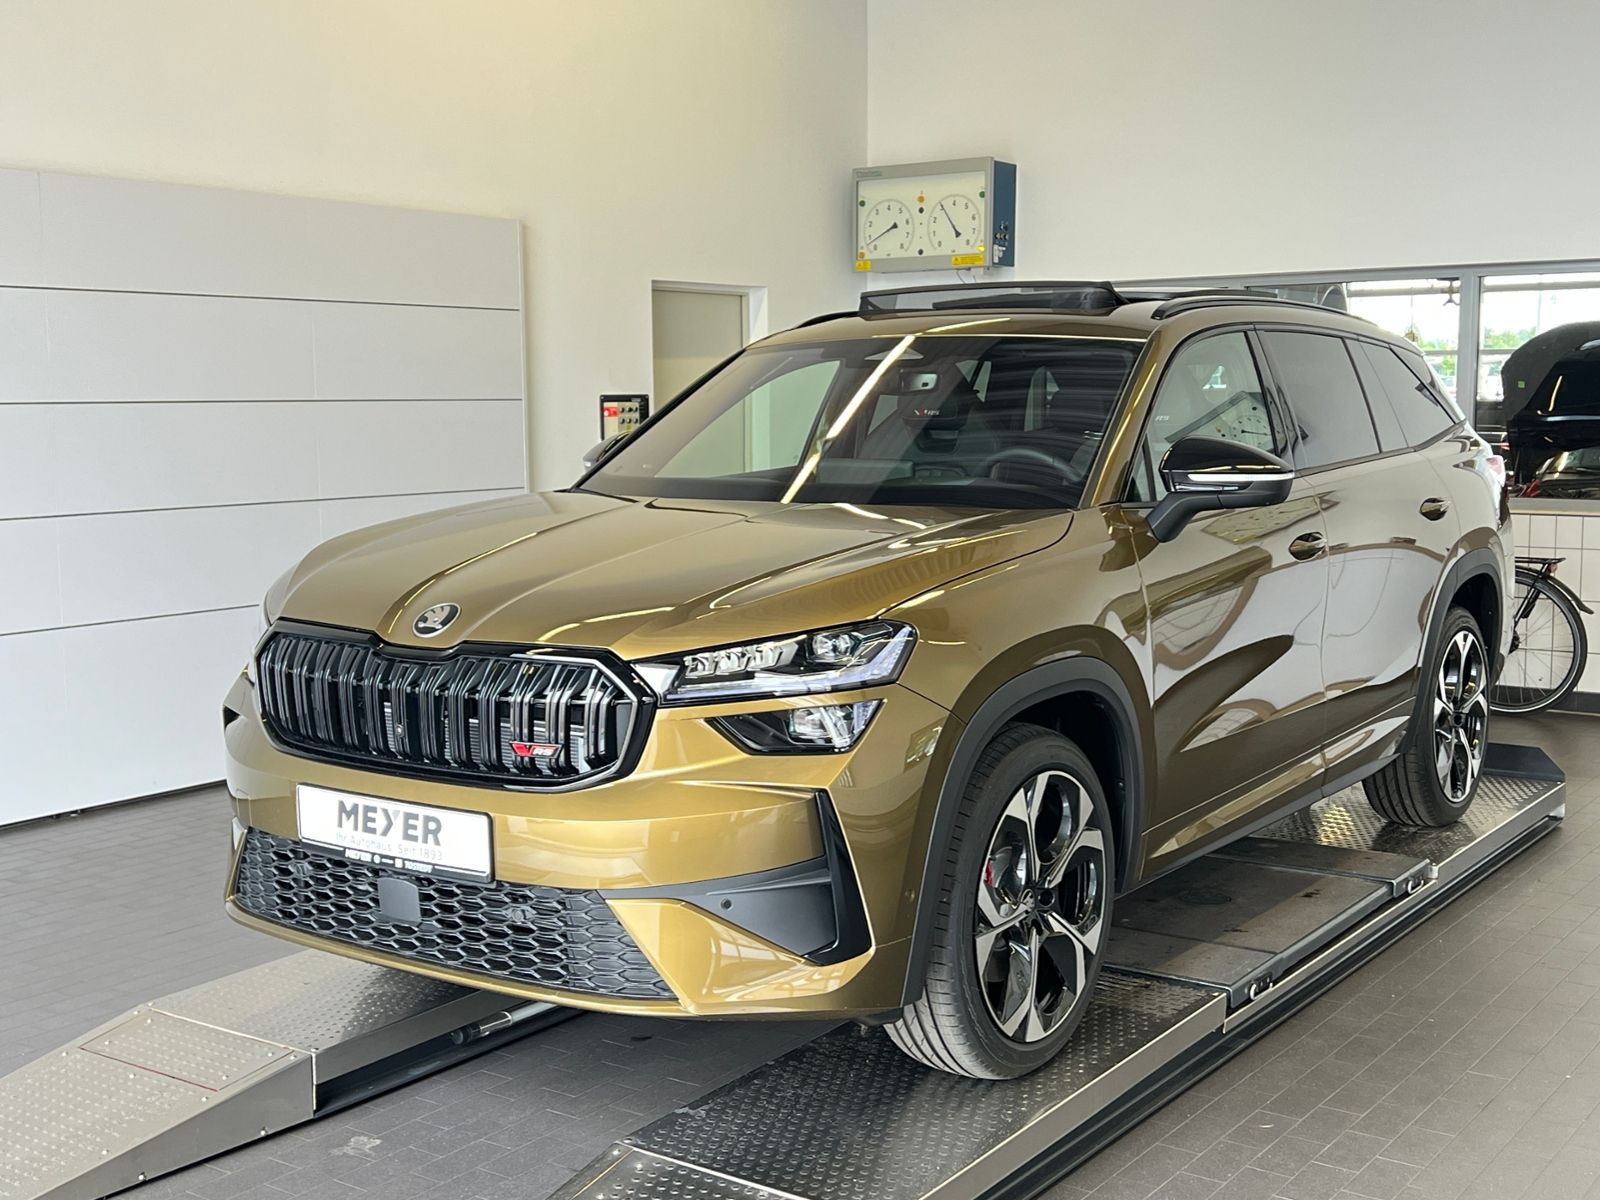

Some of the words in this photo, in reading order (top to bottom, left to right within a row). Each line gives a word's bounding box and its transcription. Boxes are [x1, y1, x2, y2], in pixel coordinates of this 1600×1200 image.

[337, 800, 442, 847] MEYER
[350, 835, 392, 852] Autohaus
[399, 844, 416, 854] Seit
[420, 847, 442, 861] 1893
